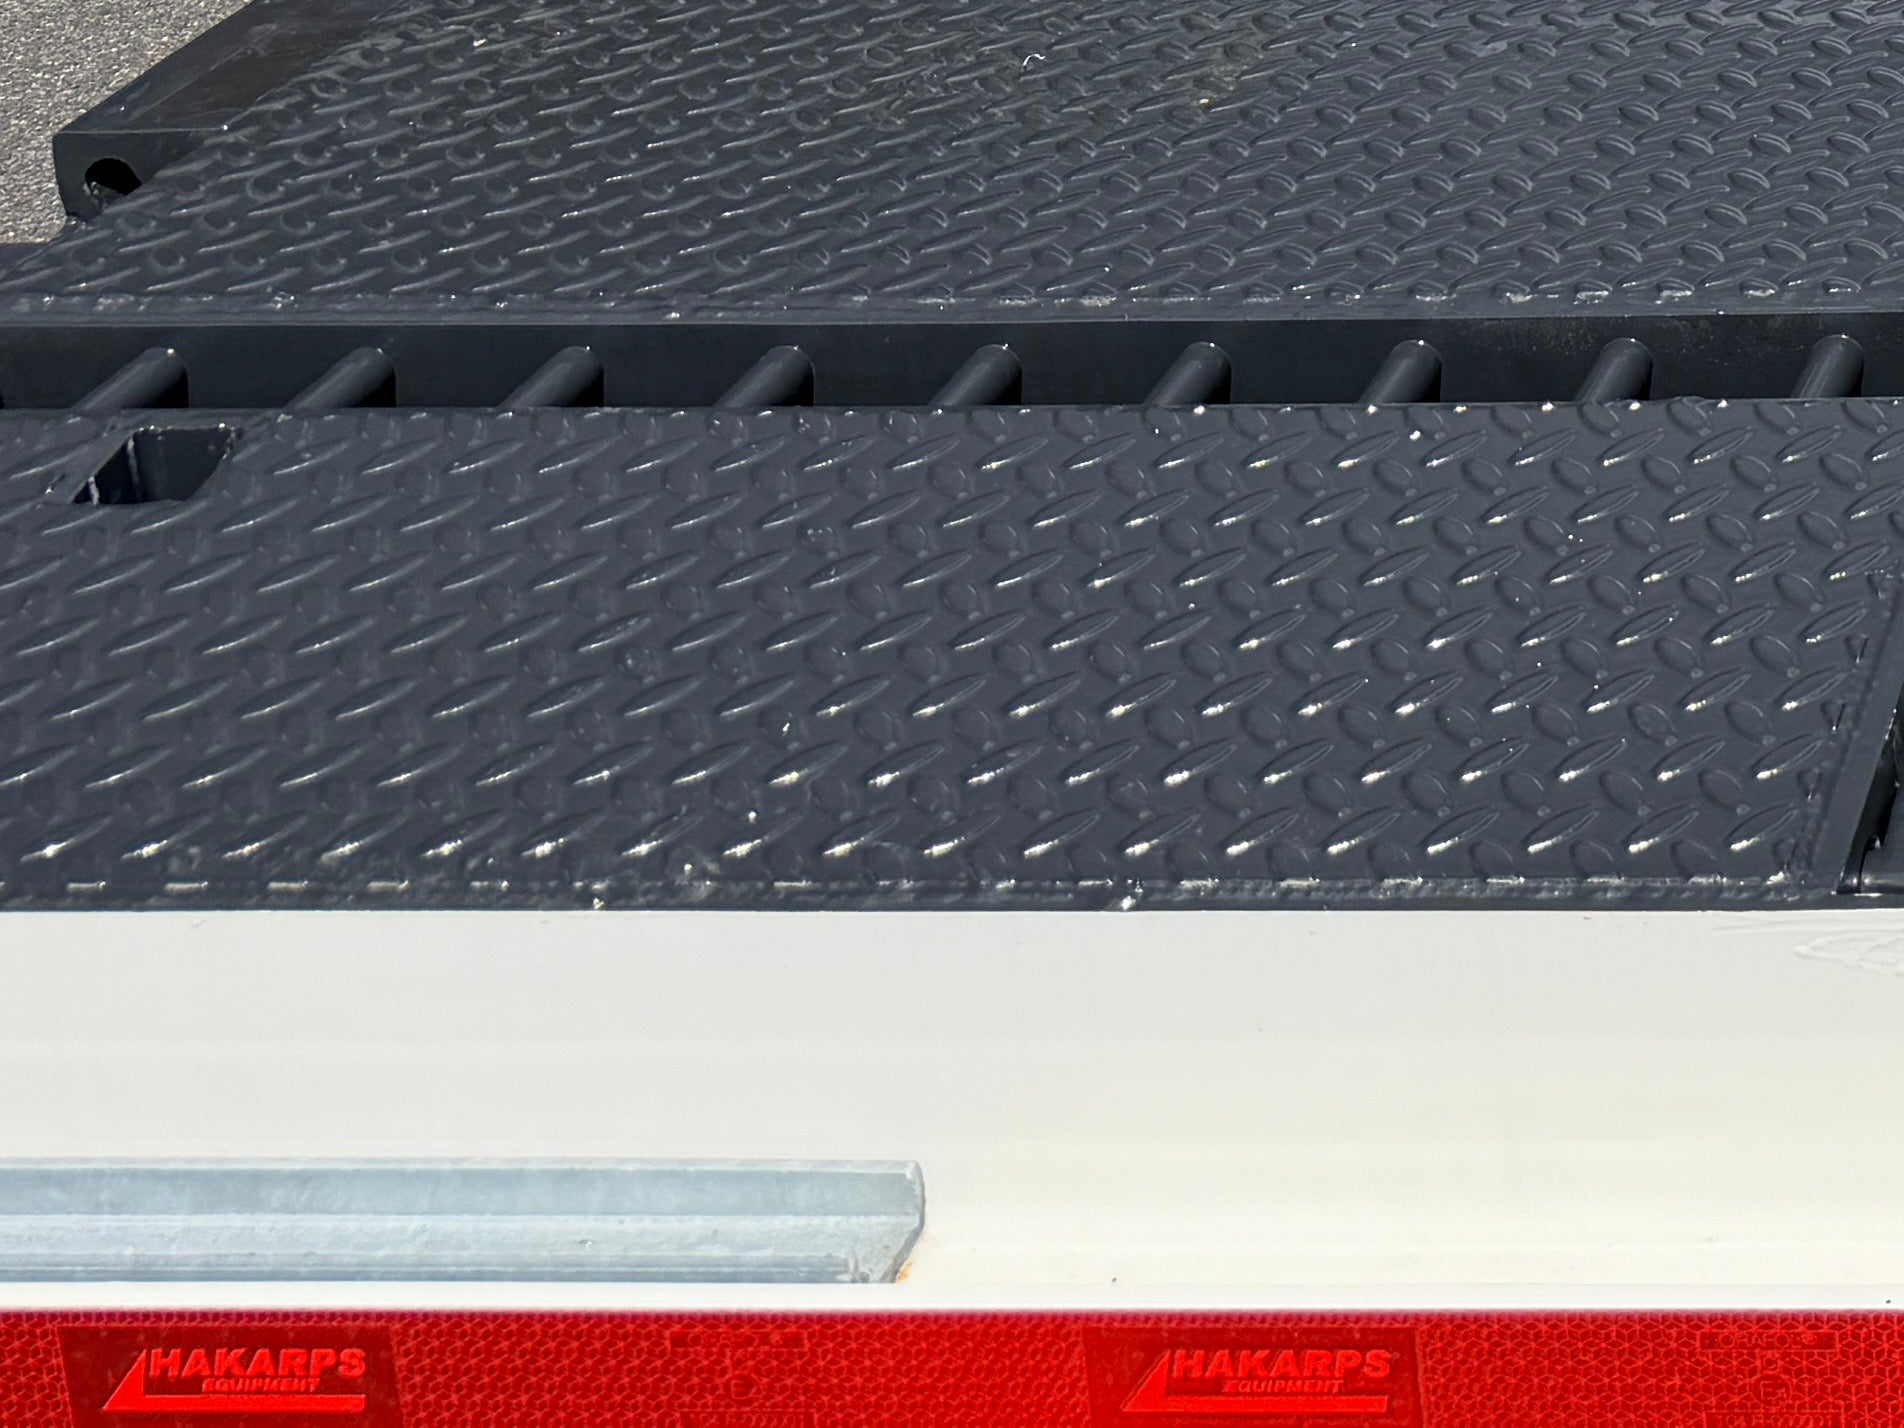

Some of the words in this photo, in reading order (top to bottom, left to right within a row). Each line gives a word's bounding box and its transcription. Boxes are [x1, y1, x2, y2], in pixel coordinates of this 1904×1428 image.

[149, 1348, 366, 1377] HAKARPS
[1172, 1349, 1391, 1378] HAKARPS
[201, 1378, 320, 1392] EQUIPMENT
[1222, 1379, 1344, 1393] EQUIPMENT
